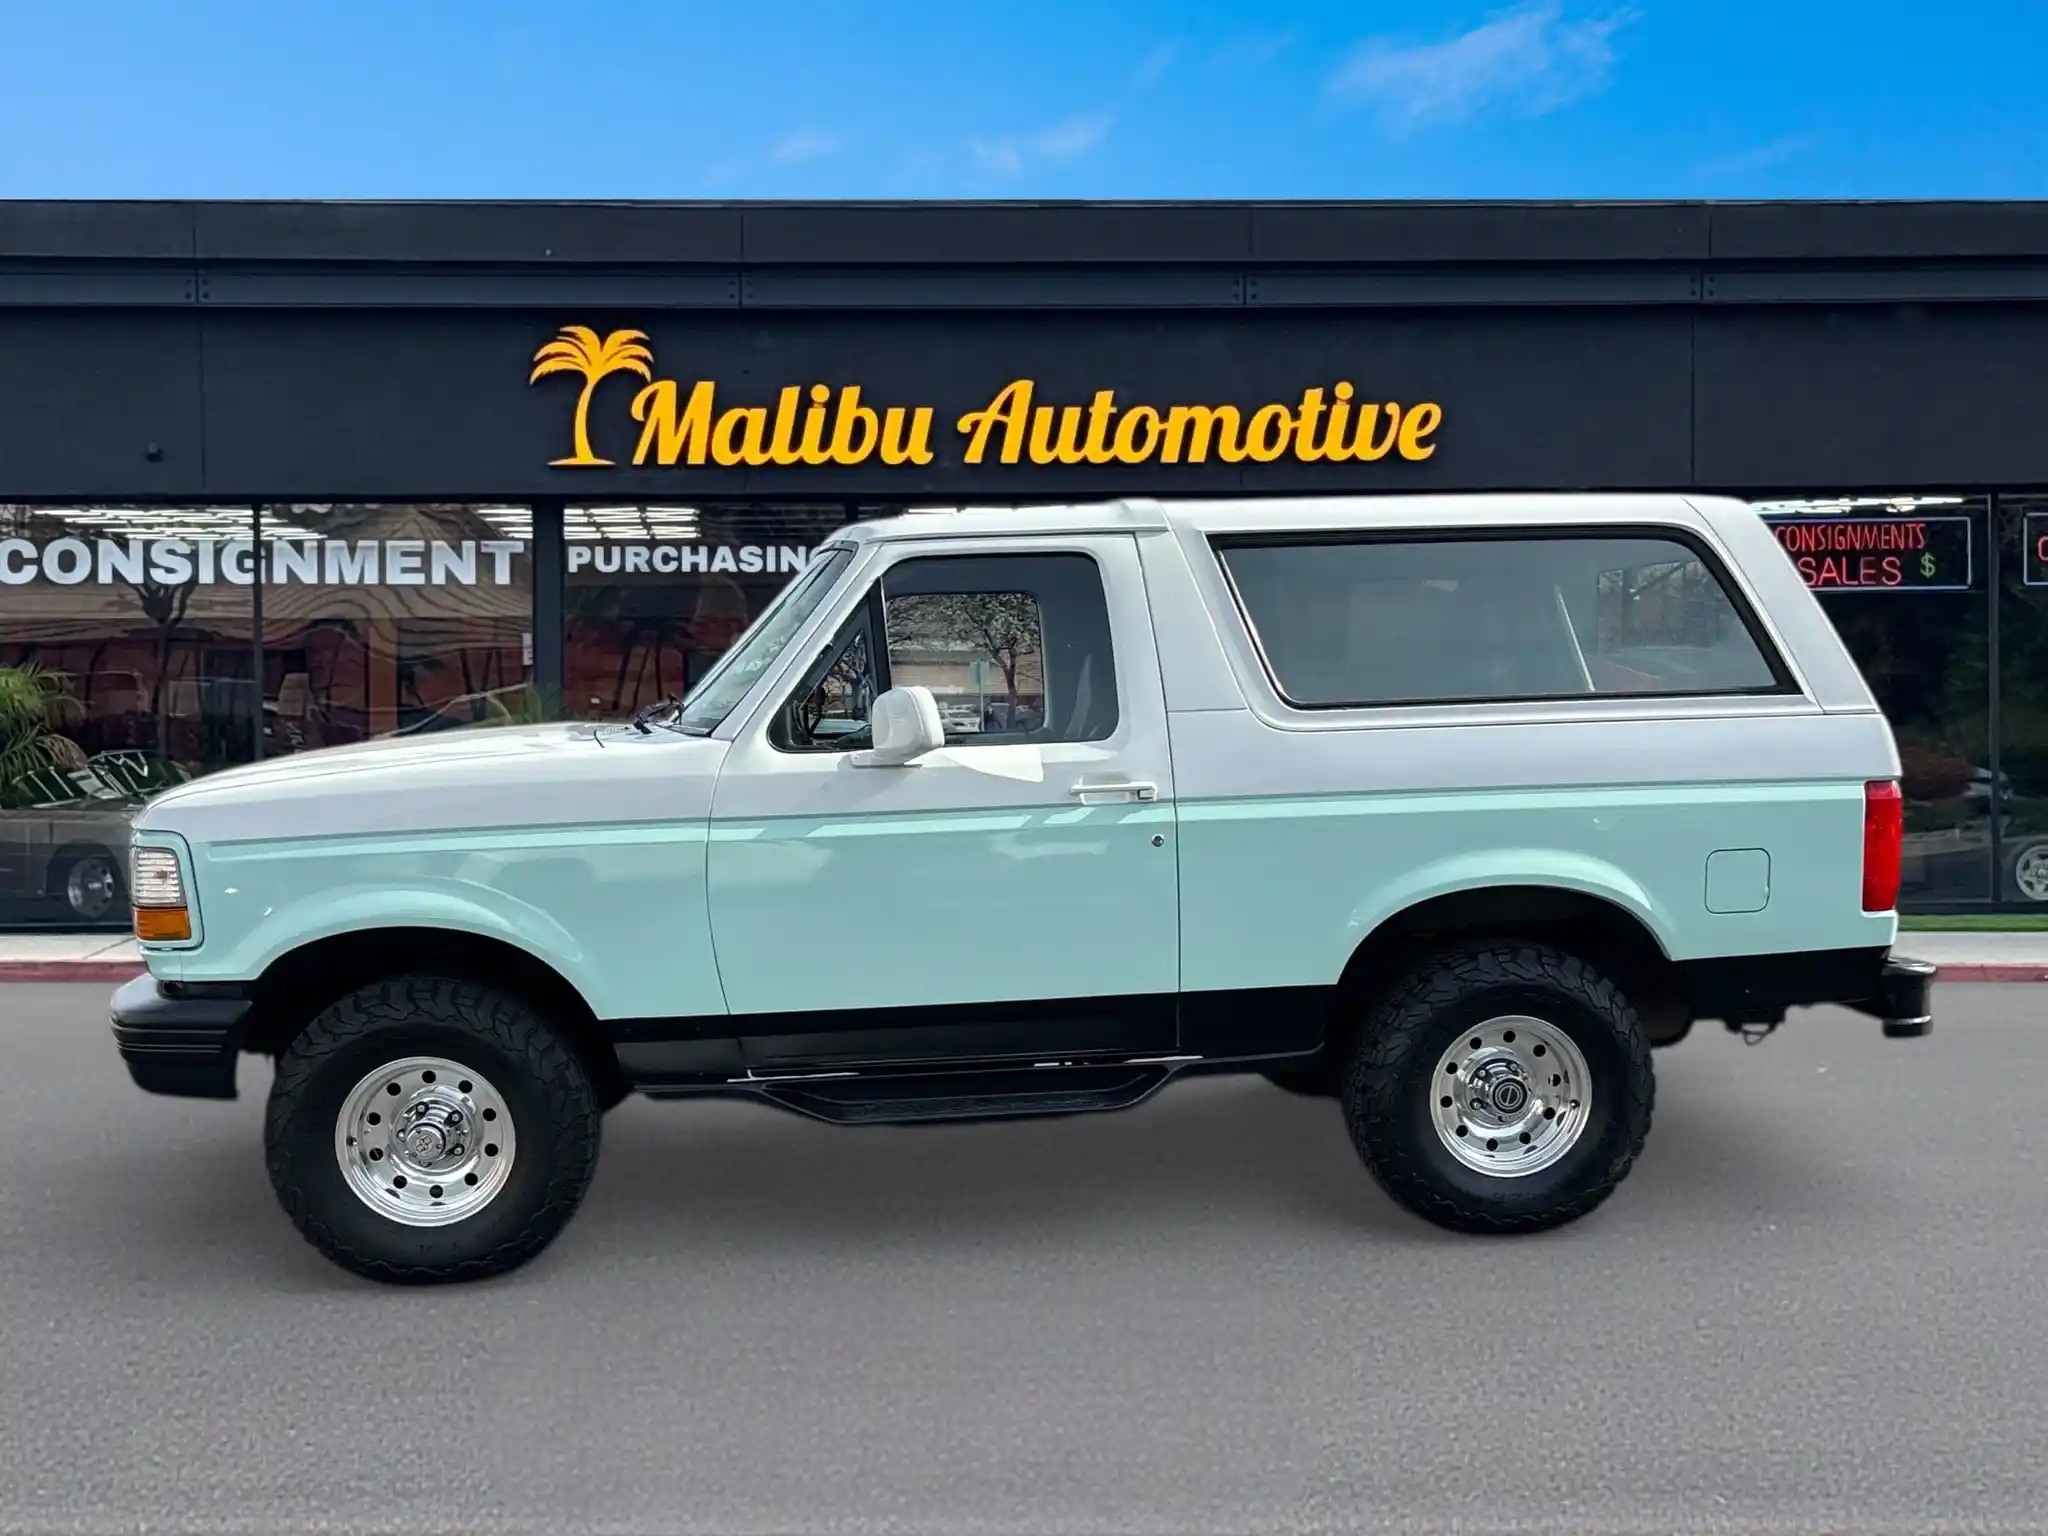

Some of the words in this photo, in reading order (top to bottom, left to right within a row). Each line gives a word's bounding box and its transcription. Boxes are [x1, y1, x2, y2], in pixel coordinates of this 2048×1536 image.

[632, 380, 934, 465] Malibu
[957, 380, 1442, 465] Automotive
[0, 537, 524, 585] CONSIGNMENT
[567, 545, 820, 573] PURCHASIN
[1797, 556, 1902, 586] SALES
